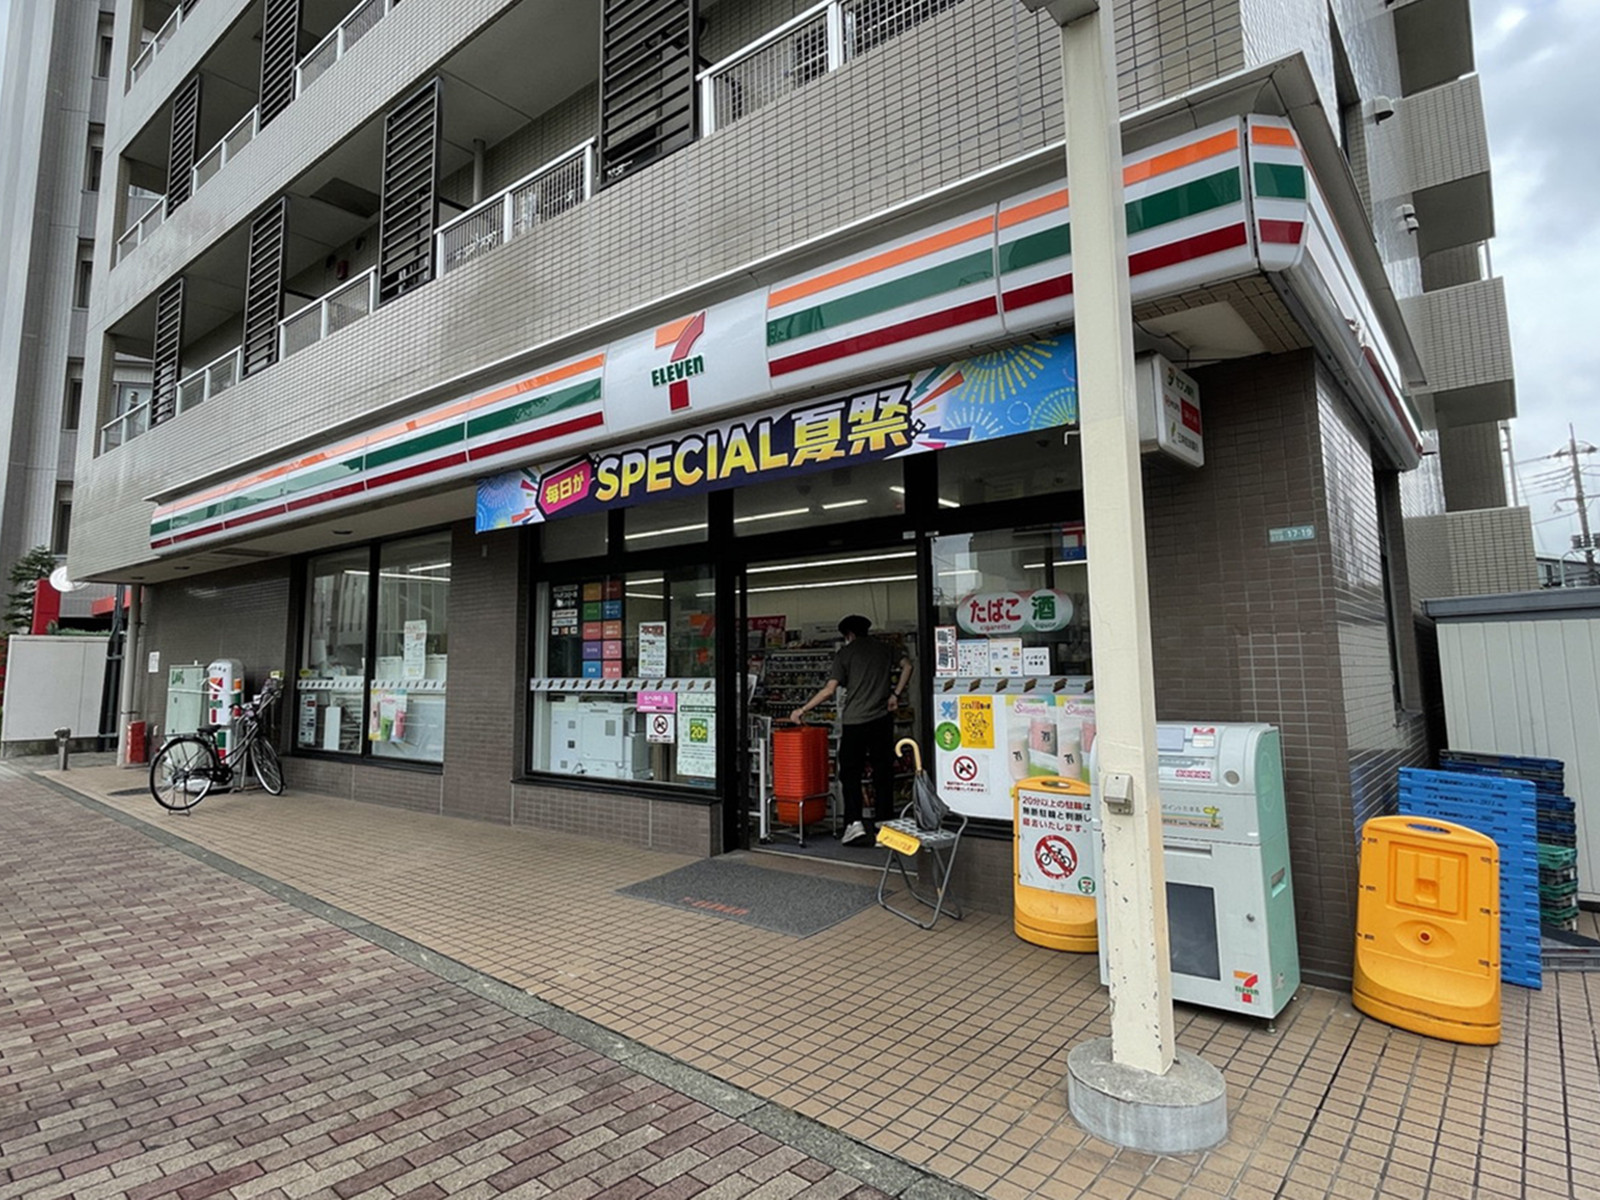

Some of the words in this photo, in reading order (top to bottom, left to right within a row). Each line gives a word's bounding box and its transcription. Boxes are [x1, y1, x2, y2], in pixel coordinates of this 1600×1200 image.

[654, 311, 706, 411] 7
[545, 471, 586, 505] 毎日が
[970, 598, 1021, 623] たばこ
[1031, 595, 1056, 620] 酒
[979, 624, 1011, 632] cigarette
[1022, 795, 1091, 811] 20分以上の駐輪は
